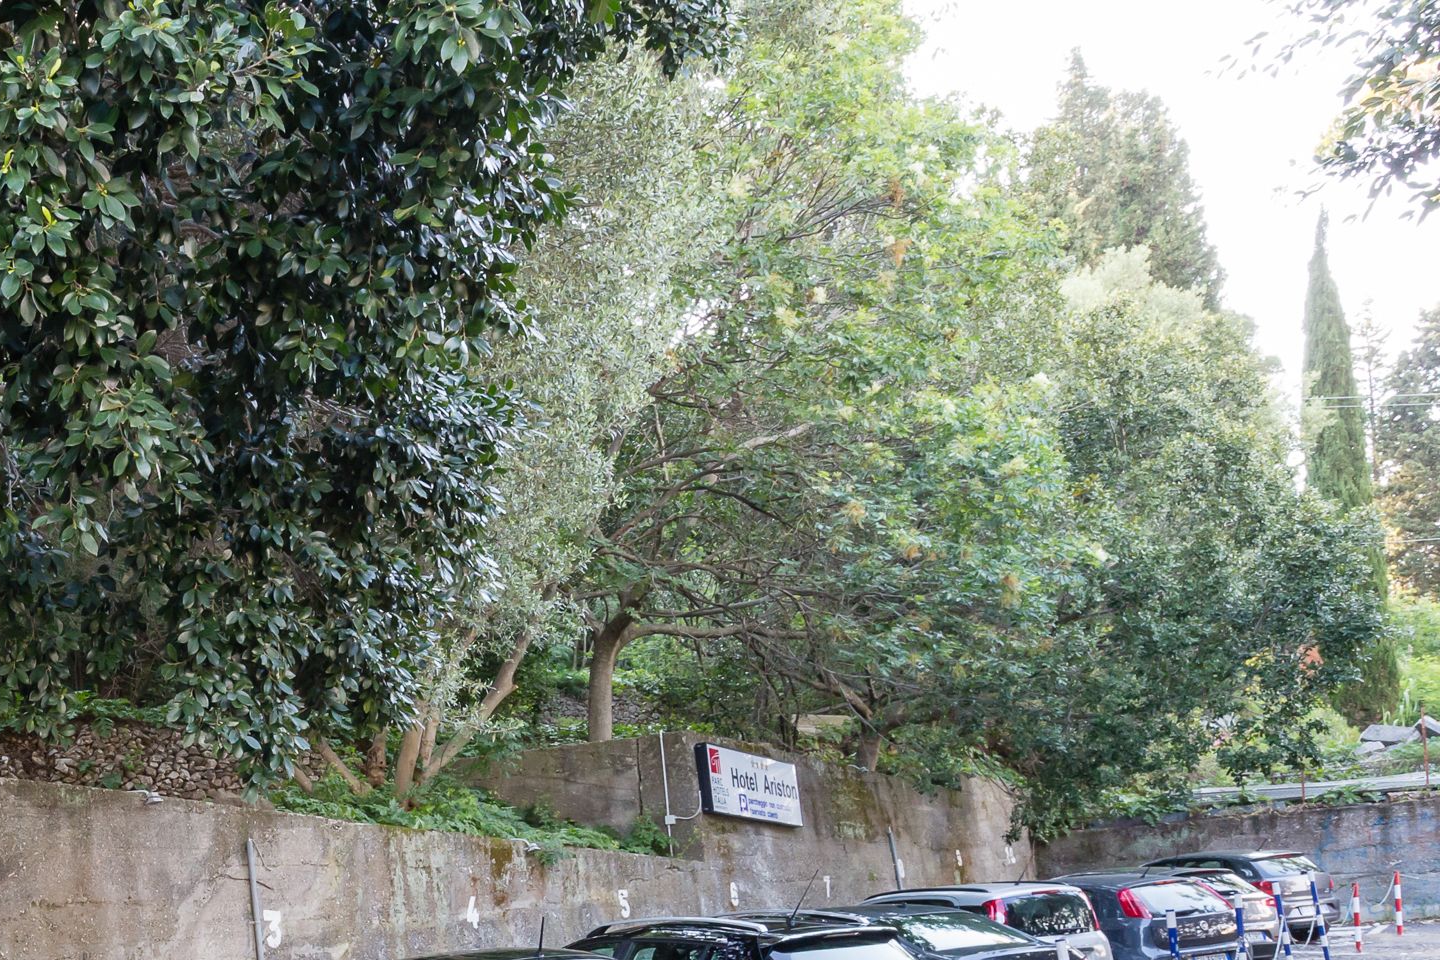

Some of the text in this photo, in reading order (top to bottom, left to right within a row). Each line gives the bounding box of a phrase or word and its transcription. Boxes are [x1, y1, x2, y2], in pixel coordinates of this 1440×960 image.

[731, 767, 798, 800] Hotel Ariston
[618, 889, 630, 918] 5
[730, 881, 739, 907] 6
[466, 896, 479, 928] 4
[263, 909, 281, 948] 3
